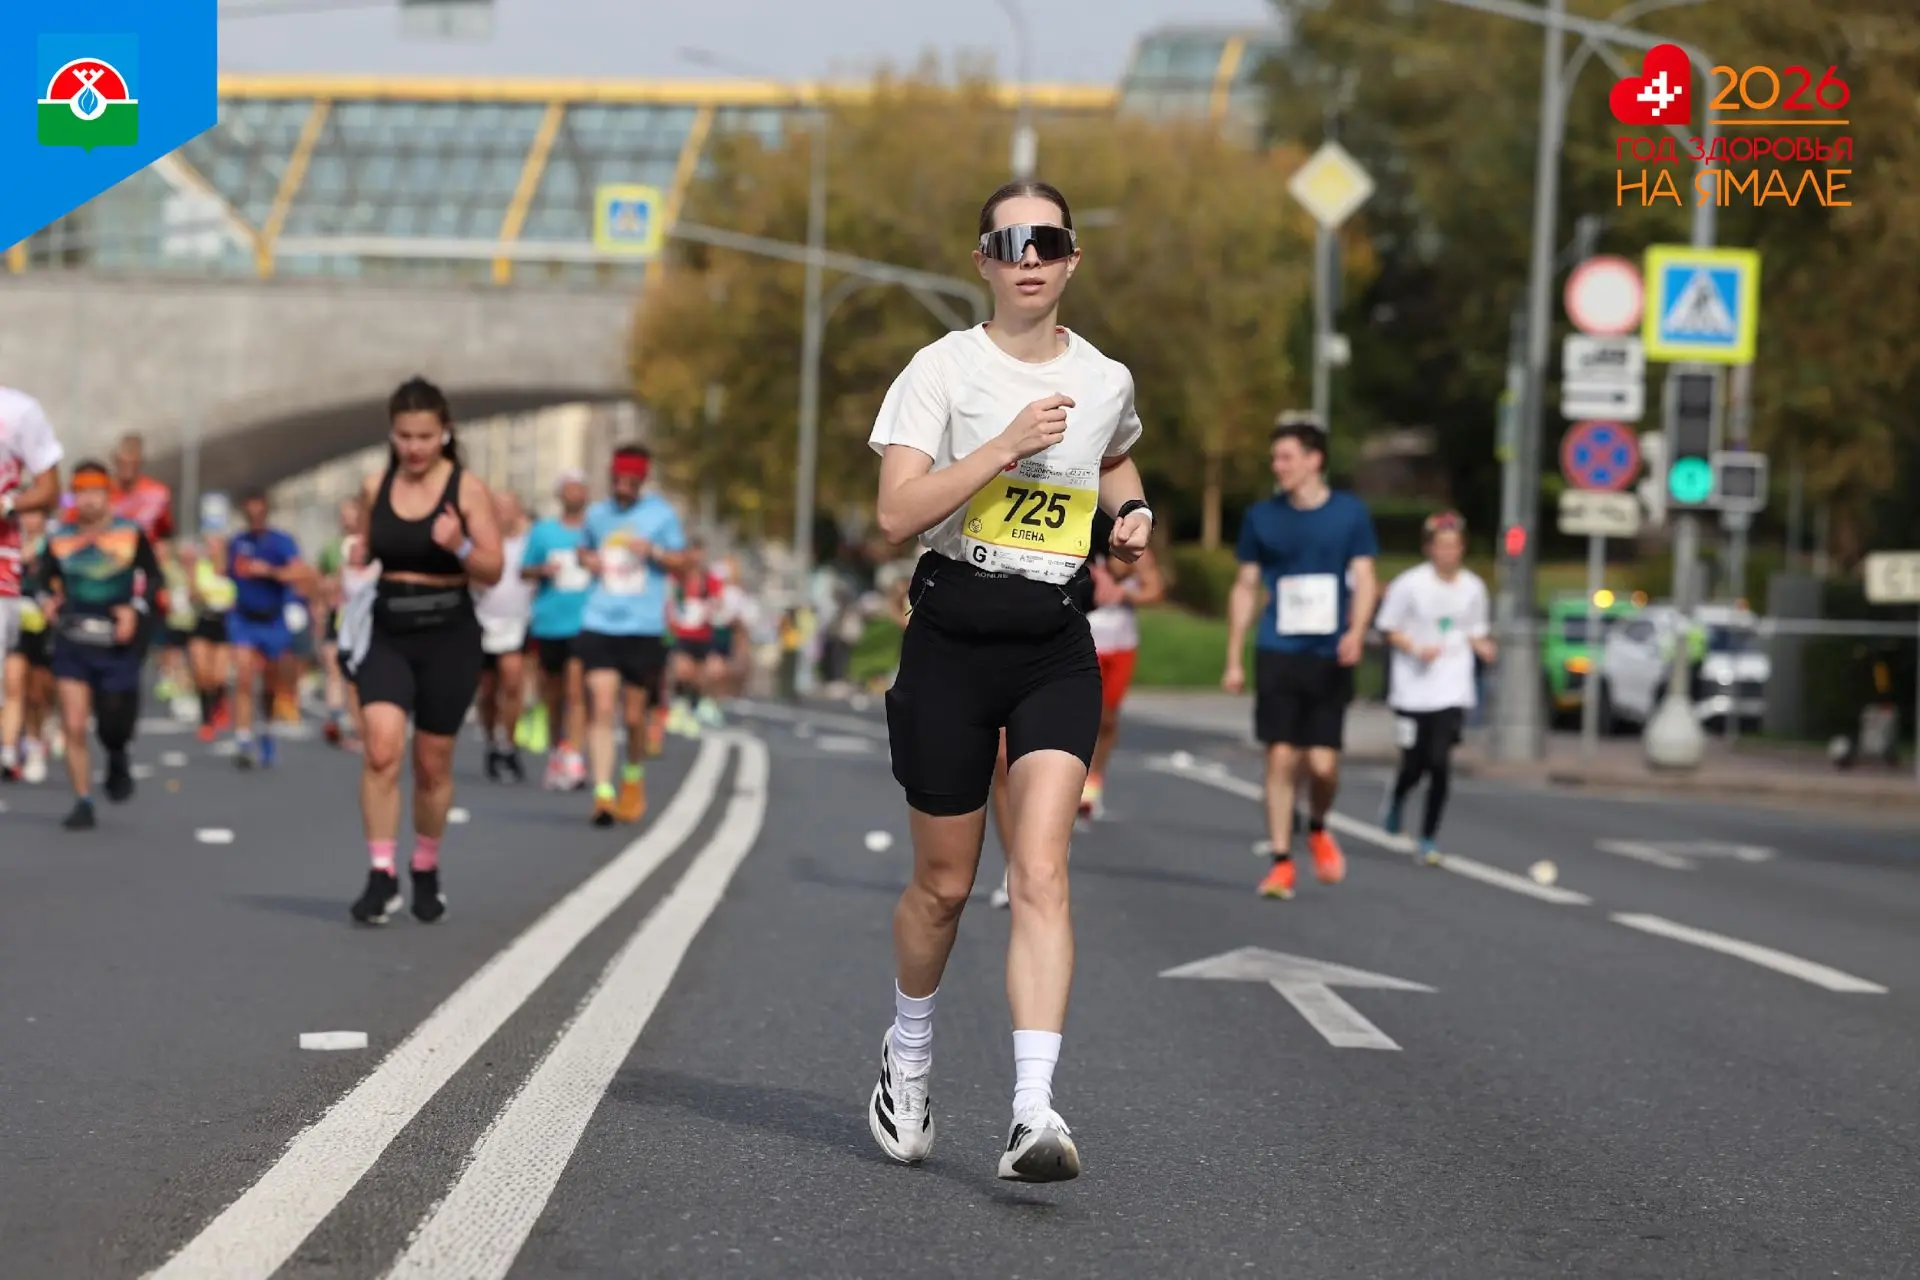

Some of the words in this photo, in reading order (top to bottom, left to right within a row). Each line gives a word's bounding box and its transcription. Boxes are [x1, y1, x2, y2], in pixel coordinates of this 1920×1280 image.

[1004, 486, 1071, 528] 725
[1011, 529, 1045, 542] ЕЛЕНА
[973, 545, 987, 563] G
